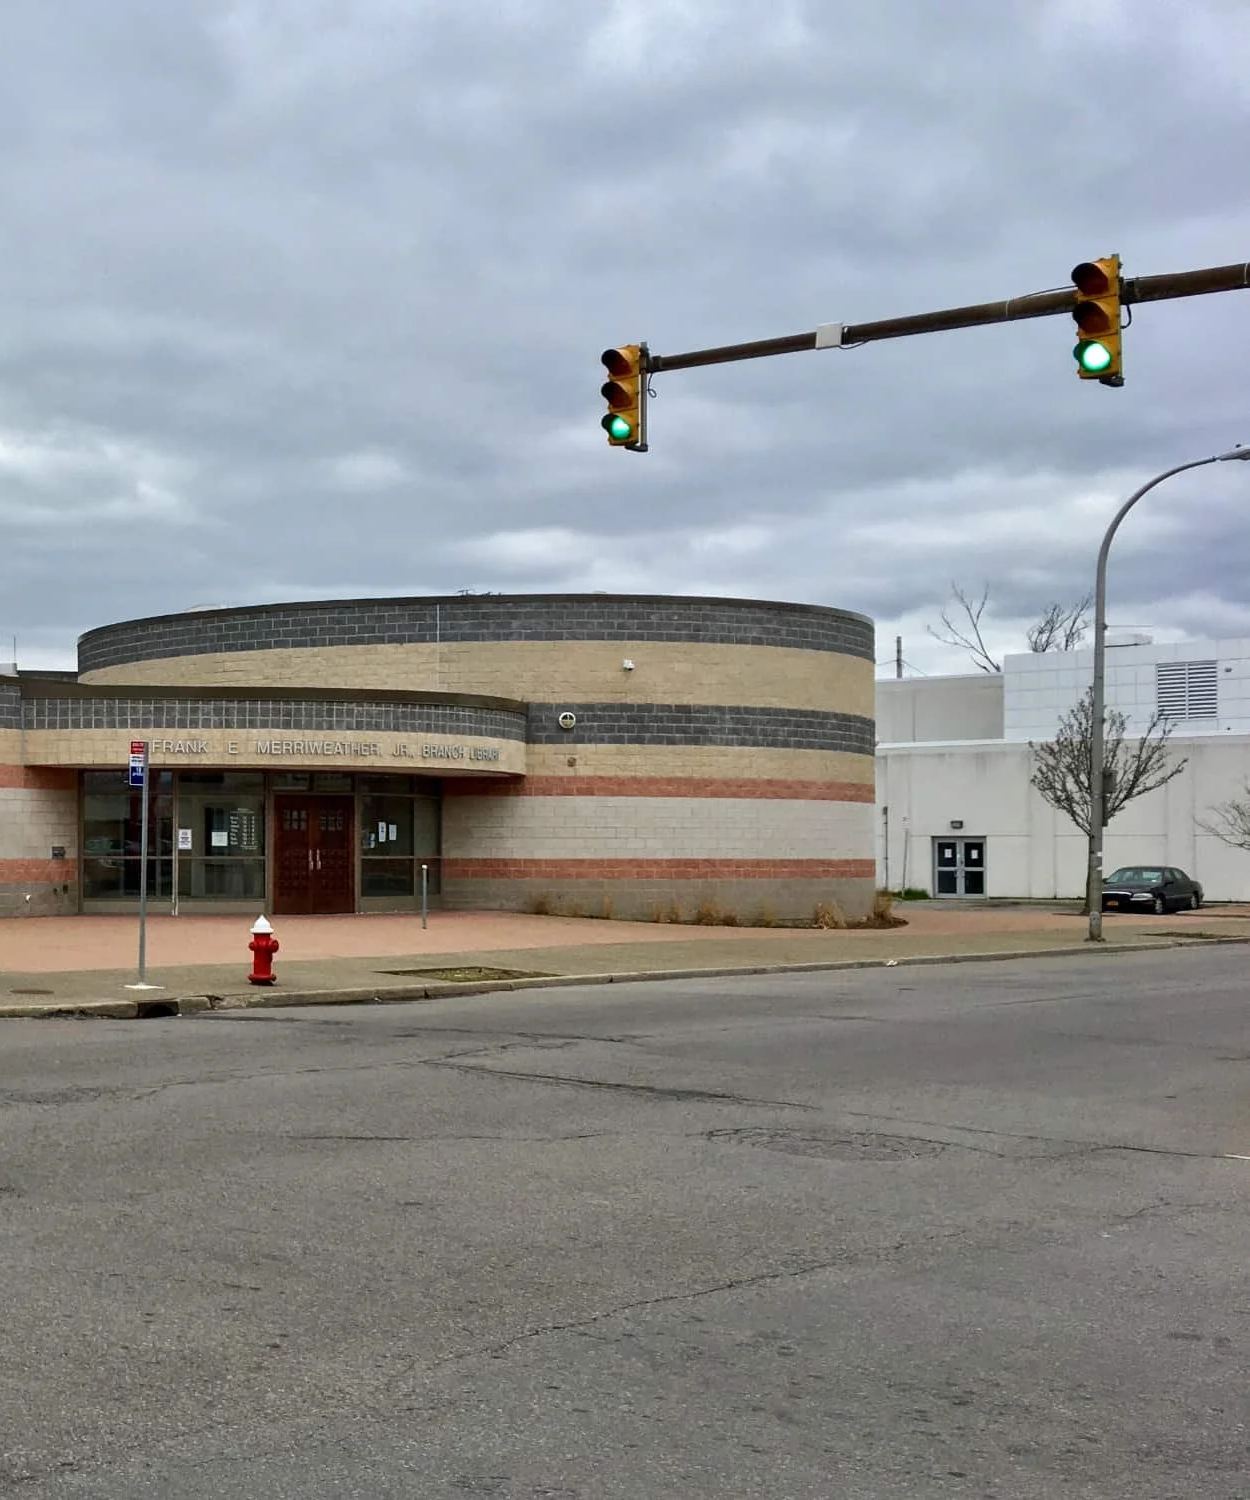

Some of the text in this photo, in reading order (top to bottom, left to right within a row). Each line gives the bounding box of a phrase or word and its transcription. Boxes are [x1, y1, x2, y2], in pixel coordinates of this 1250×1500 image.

[152, 740, 208, 754] FRANK
[228, 740, 239, 755] E
[422, 744, 467, 761] BRANCH
